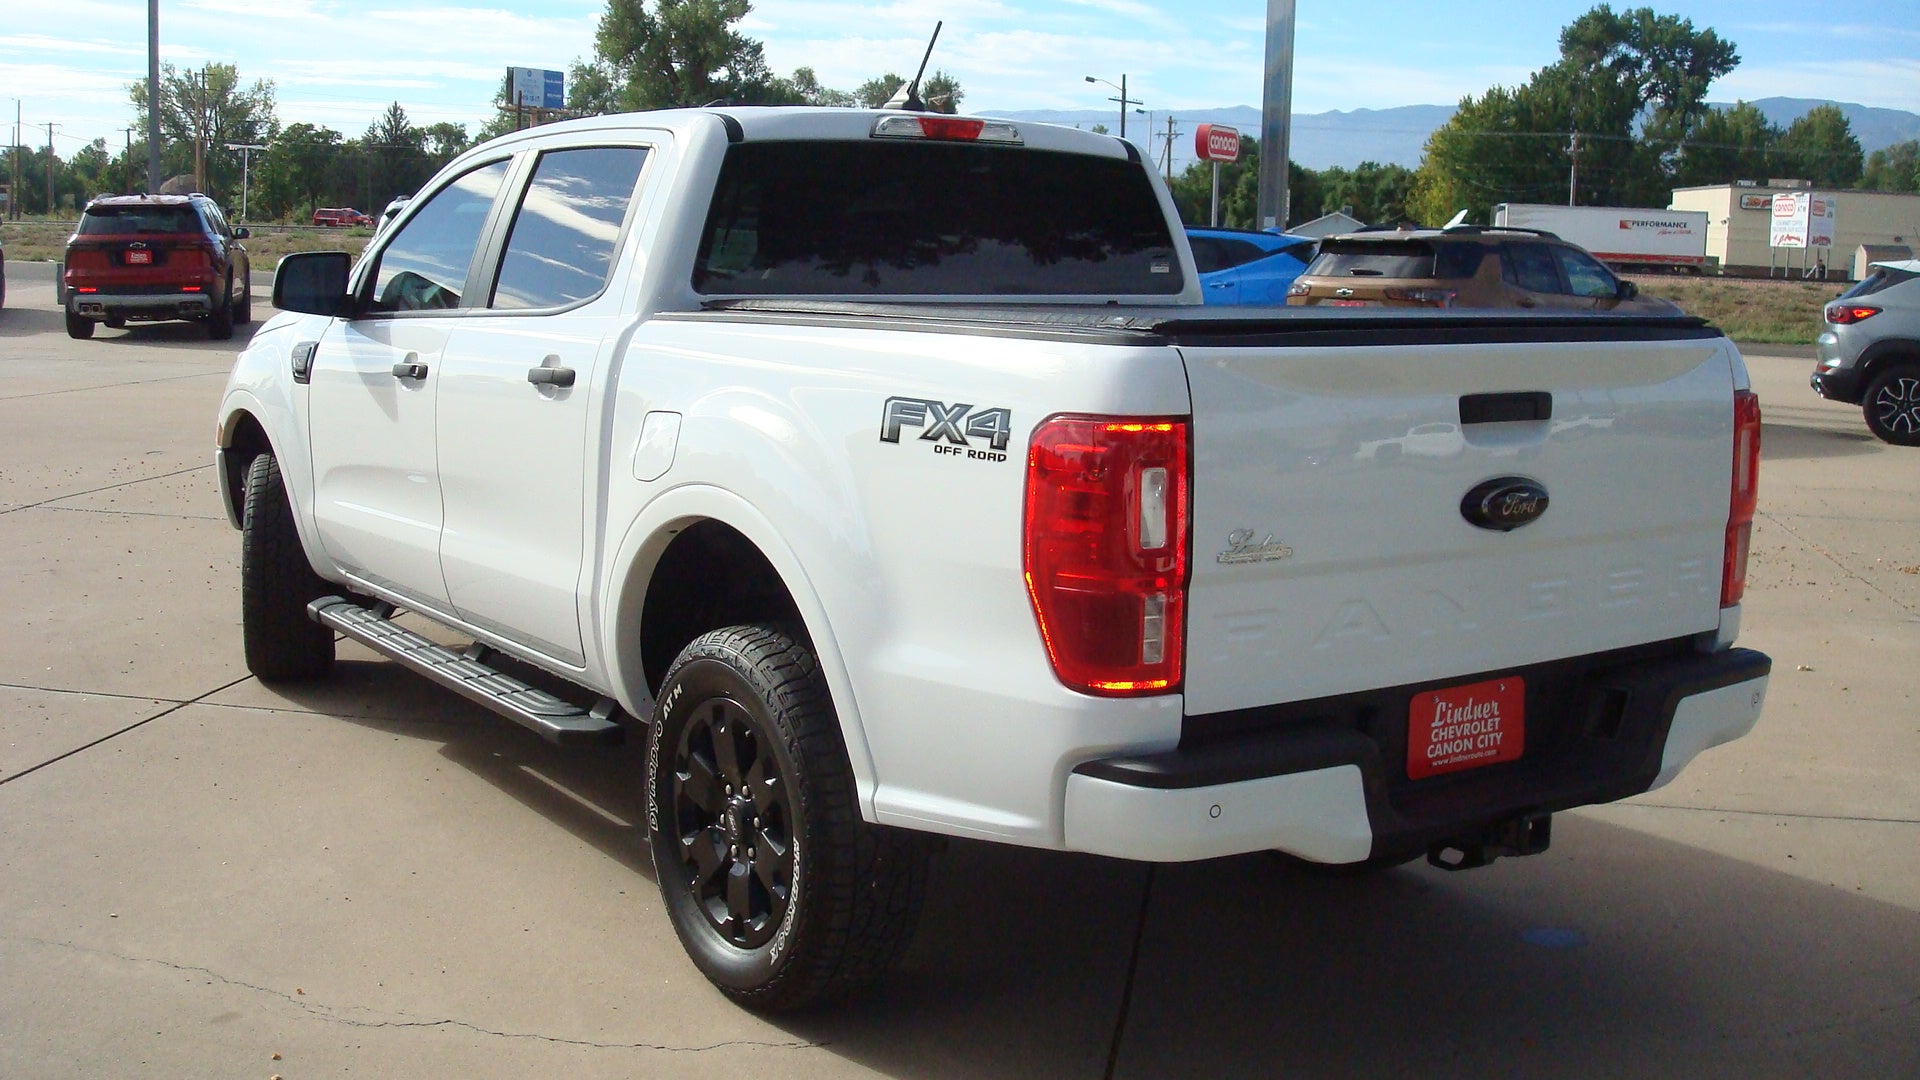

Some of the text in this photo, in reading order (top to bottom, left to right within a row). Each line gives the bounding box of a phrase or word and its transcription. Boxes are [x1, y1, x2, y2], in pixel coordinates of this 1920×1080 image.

[1632, 220, 1688, 229] PERFORMANCE
[879, 396, 1011, 451] FX4
[934, 445, 1007, 462] OFF ROAD
[1502, 492, 1537, 515] Ford
[1431, 697, 1500, 728] Lindner
[1431, 717, 1501, 743] CHEVROLET
[1427, 731, 1503, 759] CANON CITY
